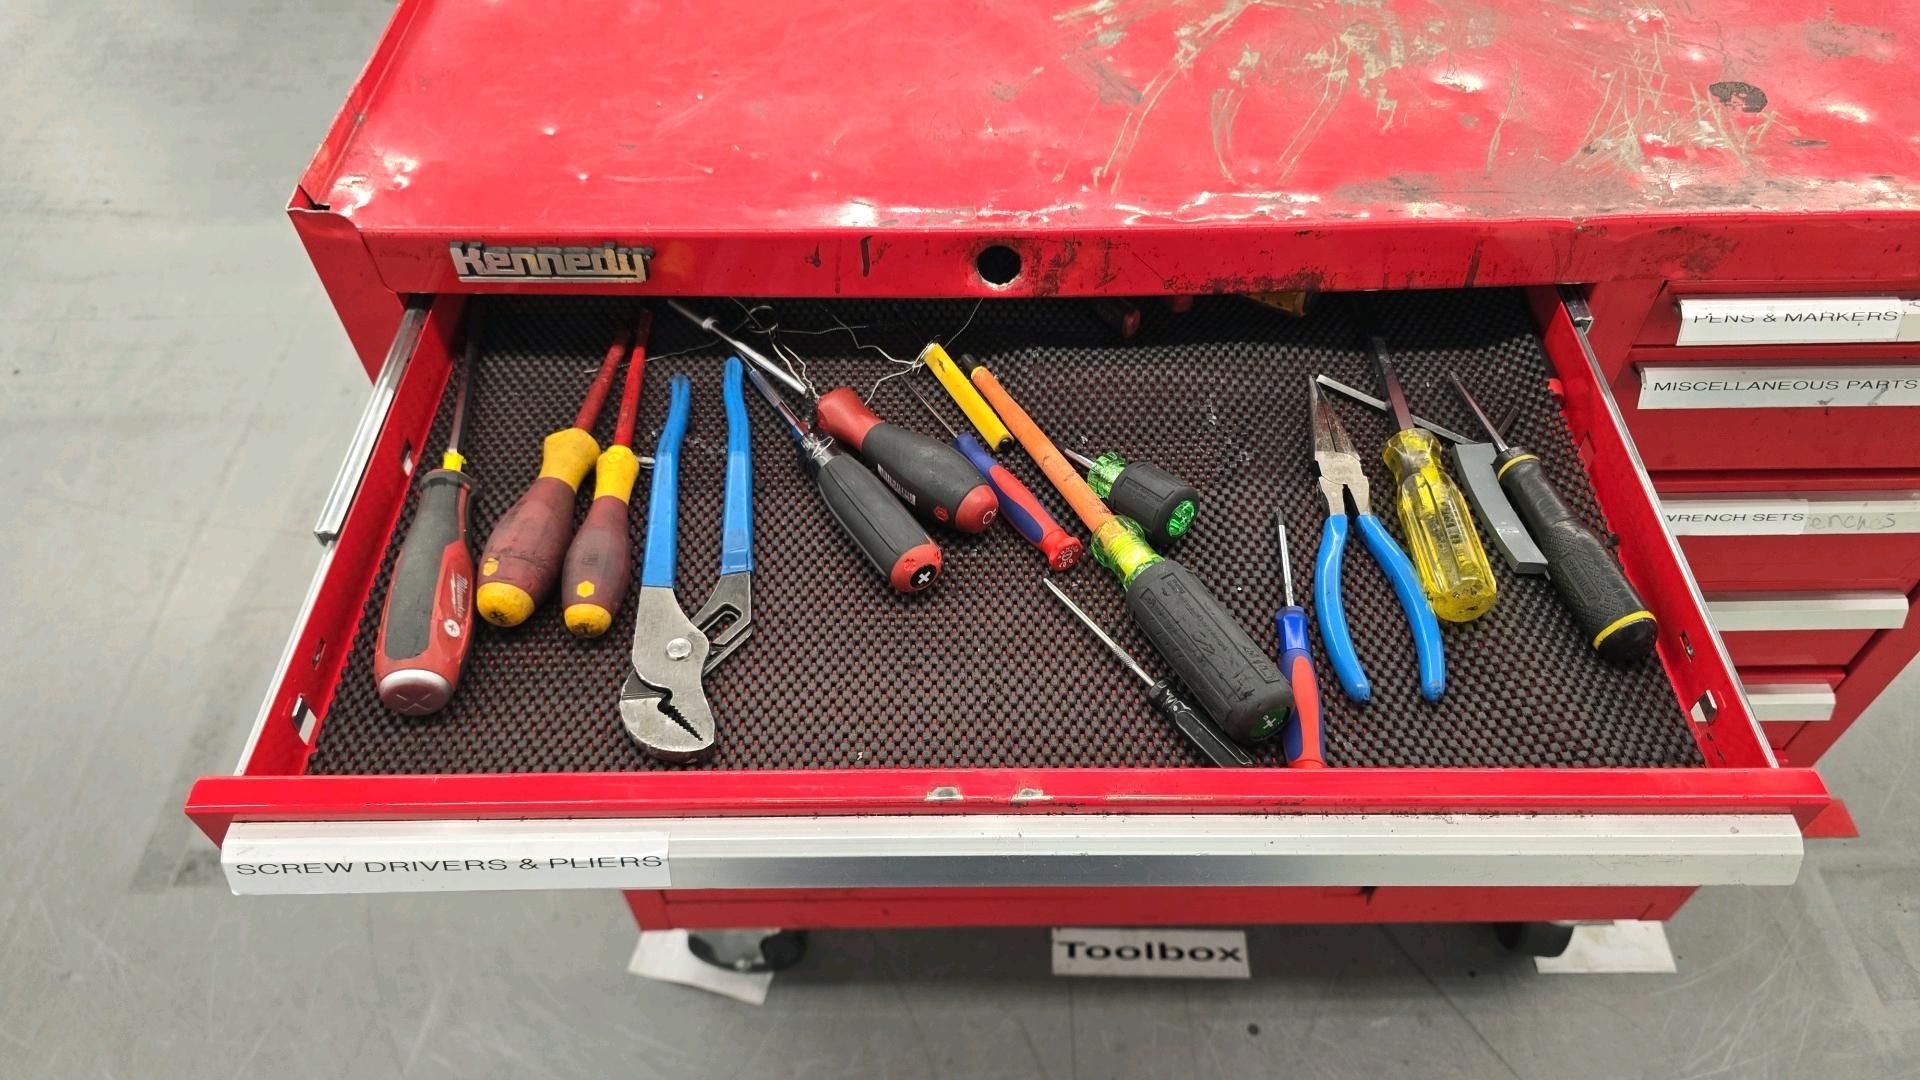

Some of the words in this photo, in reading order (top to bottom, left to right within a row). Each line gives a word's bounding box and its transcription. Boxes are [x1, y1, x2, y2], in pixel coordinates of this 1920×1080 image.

[449, 241, 655, 282] Kennedy
[1693, 312, 1755, 324] PENS
[1762, 313, 1777, 323] &
[1784, 310, 1899, 322] MARKERS
[1653, 379, 1840, 392] MISCELLANEOUS
[1846, 378, 1919, 390] PARTS
[1752, 512, 1805, 522] SETS
[235, 862, 353, 875] SCREW
[364, 860, 508, 873] DRIVERS
[519, 858, 539, 870] &
[548, 855, 663, 869] PLIERS
[1058, 941, 1242, 962] Toolbox
